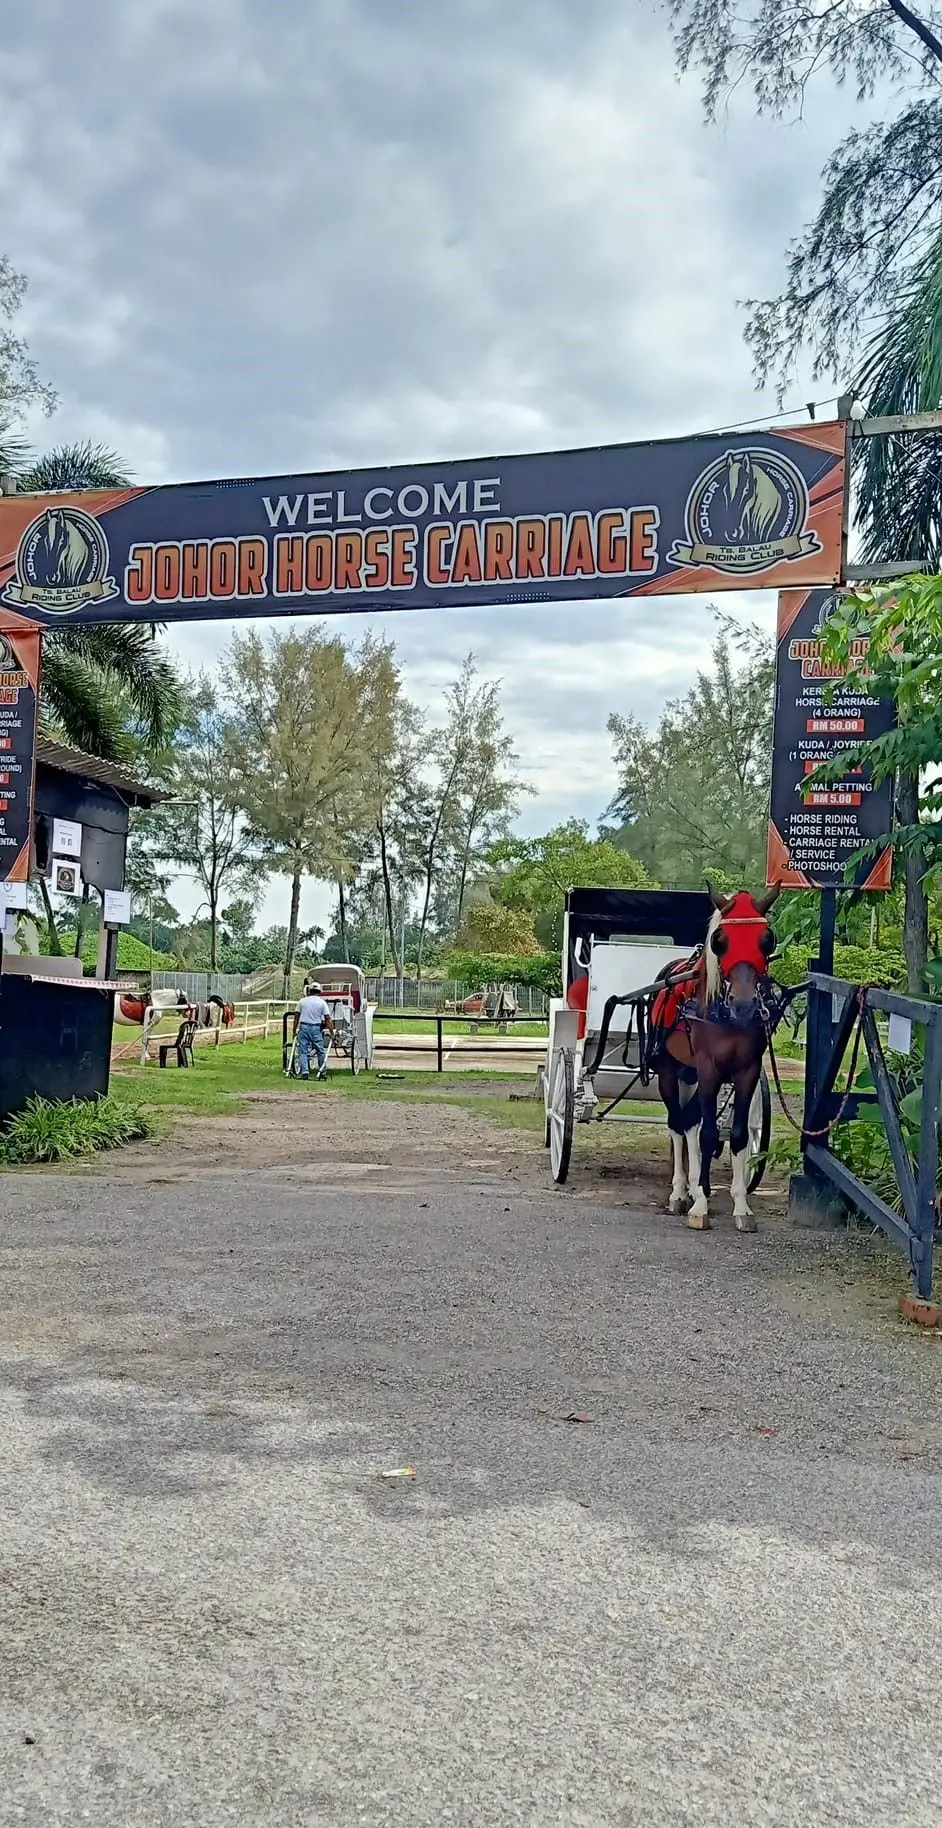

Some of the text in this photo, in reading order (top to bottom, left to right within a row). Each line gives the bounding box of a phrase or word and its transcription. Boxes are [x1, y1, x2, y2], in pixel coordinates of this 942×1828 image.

[262, 477, 501, 528] WELCOME
[699, 480, 720, 538] JOHOR
[766, 466, 789, 491] HORSE
[738, 543, 772, 553] BALAU
[26, 532, 42, 580] JOHOR
[124, 505, 660, 605] JOHOR HORSE CARRIAGE
[705, 548, 785, 562] RIDING CLUB
[31, 591, 90, 601] RIDING CLUB
[823, 708, 861, 718] ORANG)
[812, 721, 858, 730] RM 50.00
[798, 740, 825, 749] KUDA
[832, 782, 873, 792] PETTING
[813, 794, 852, 804] RM 5.00
[790, 814, 822, 824] HORSE
[824, 814, 858, 824] RIDING
[789, 826, 822, 835] HORSE
[824, 826, 861, 836] RENTAL
[789, 838, 838, 847] CARRIAGE
[839, 838, 874, 848] RENTA
[795, 849, 836, 859] SERVICE
[788, 861, 847, 871] PHOTOSHOO
